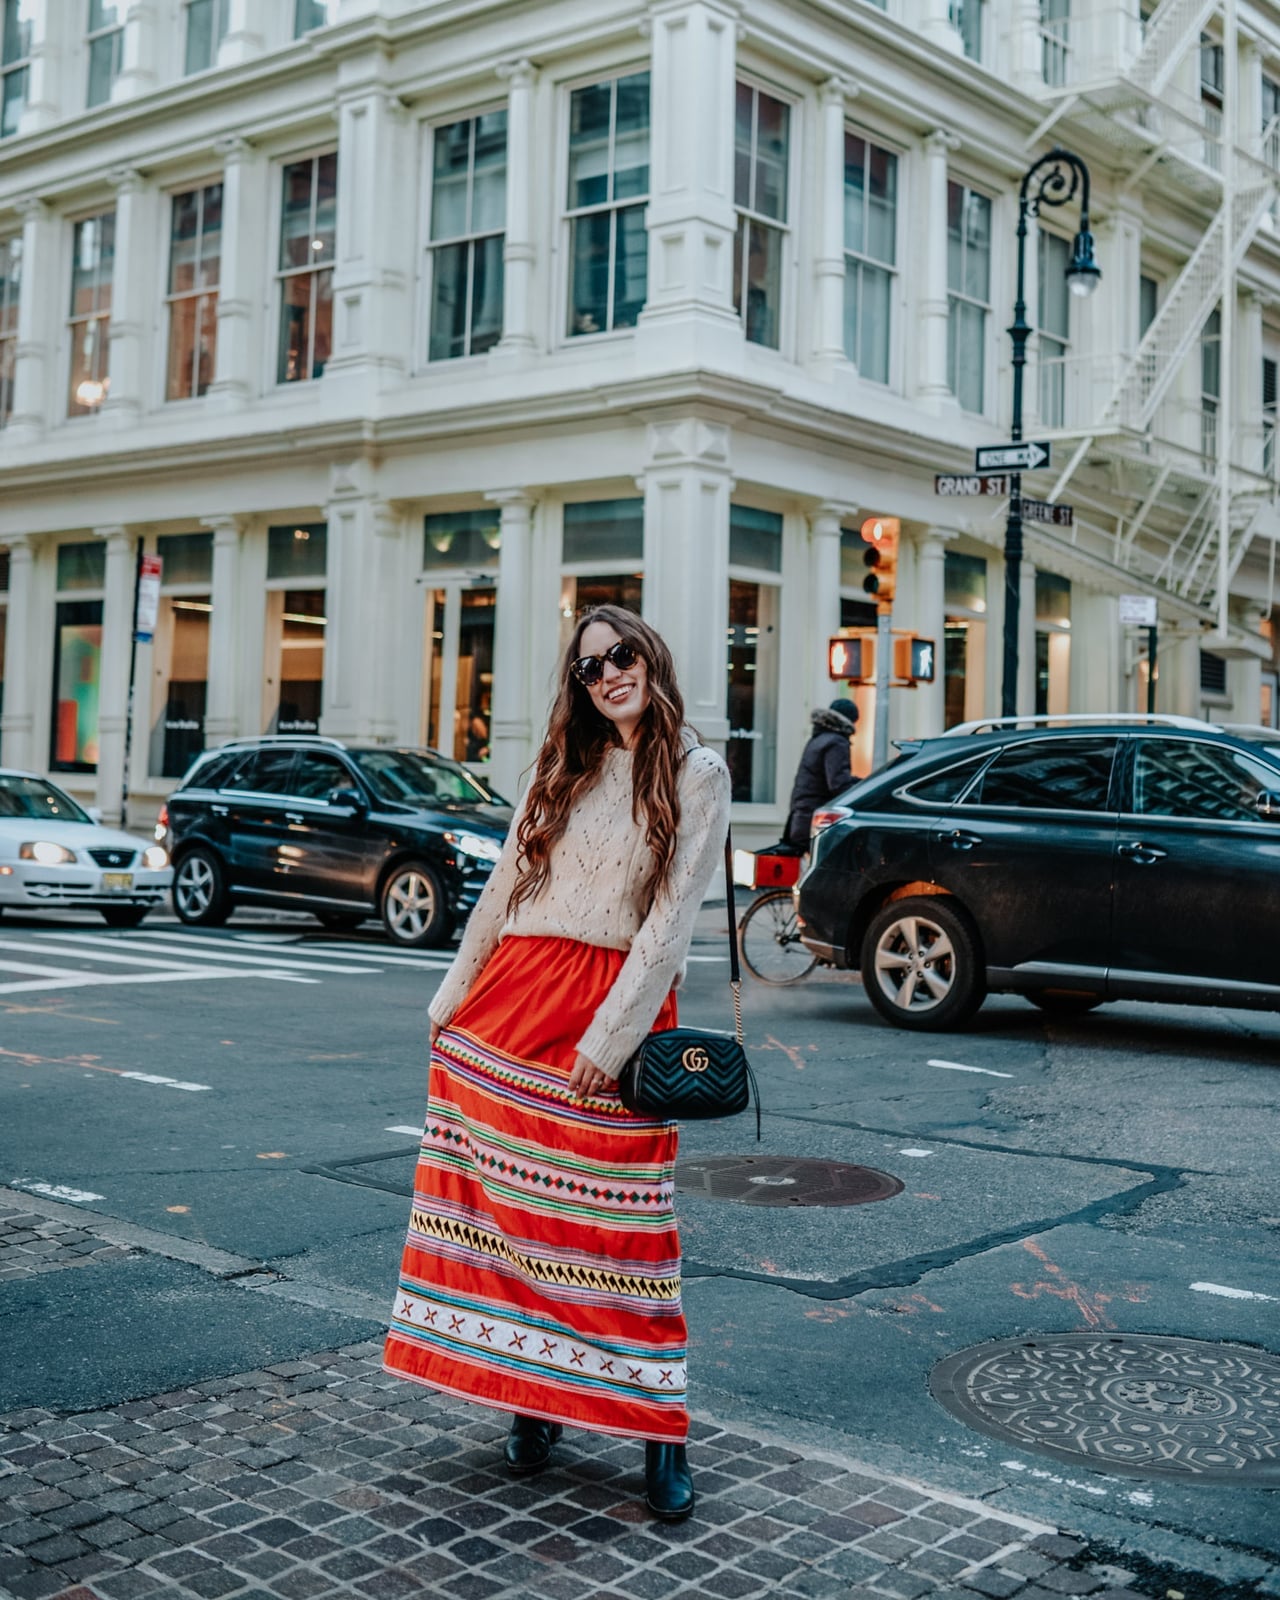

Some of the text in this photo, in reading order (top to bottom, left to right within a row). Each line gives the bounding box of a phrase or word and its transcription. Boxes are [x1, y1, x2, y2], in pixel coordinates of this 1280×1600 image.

[985, 450, 1039, 465] ONE WAY
[938, 477, 1002, 496] GRAND ST
[1023, 502, 1071, 526] GREENE ST
